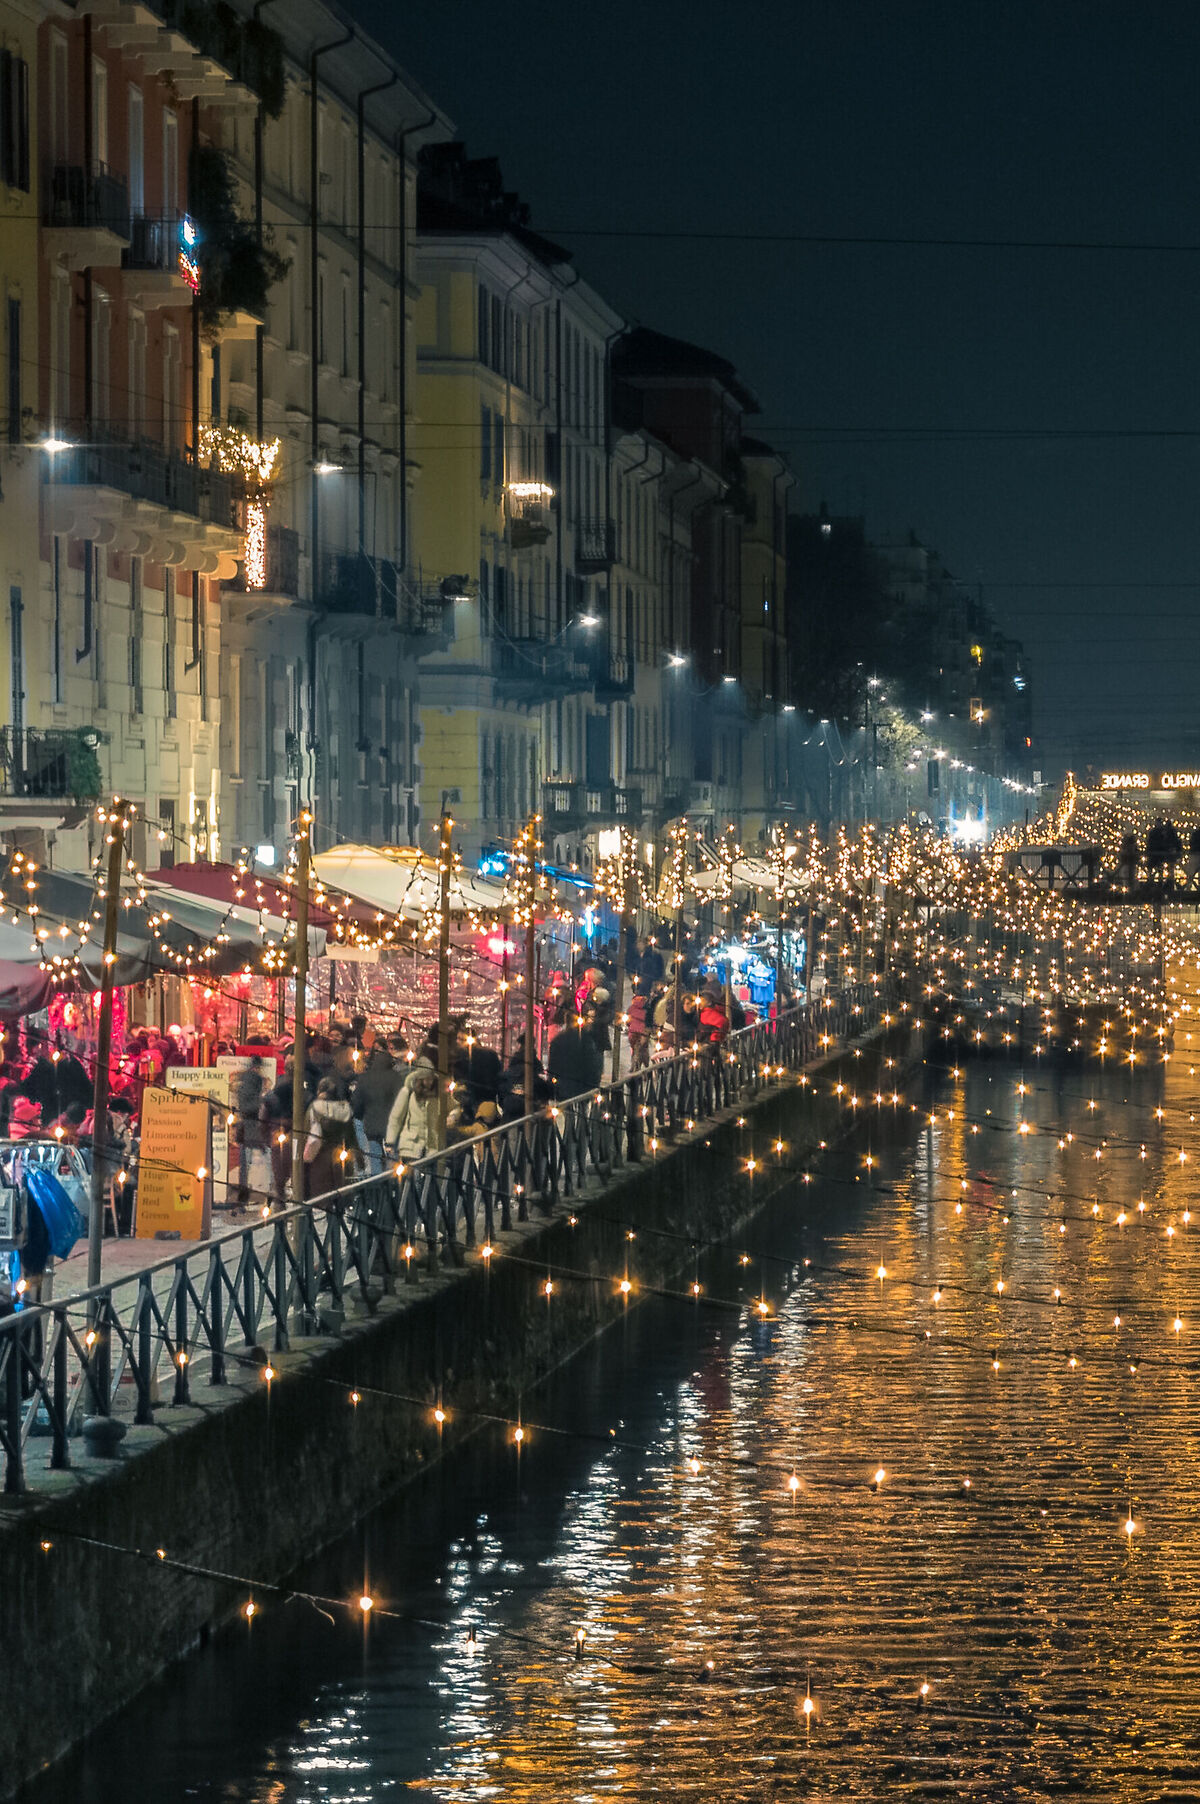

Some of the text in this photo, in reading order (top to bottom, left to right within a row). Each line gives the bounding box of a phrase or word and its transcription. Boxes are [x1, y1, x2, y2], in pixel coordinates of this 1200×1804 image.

[172, 1070, 224, 1081] Happy Hour
[150, 1092, 186, 1105] Spritz
[147, 1117, 182, 1126] Passion
[146, 1131, 197, 1139] Limoncello
[146, 1145, 176, 1153] Aperol
